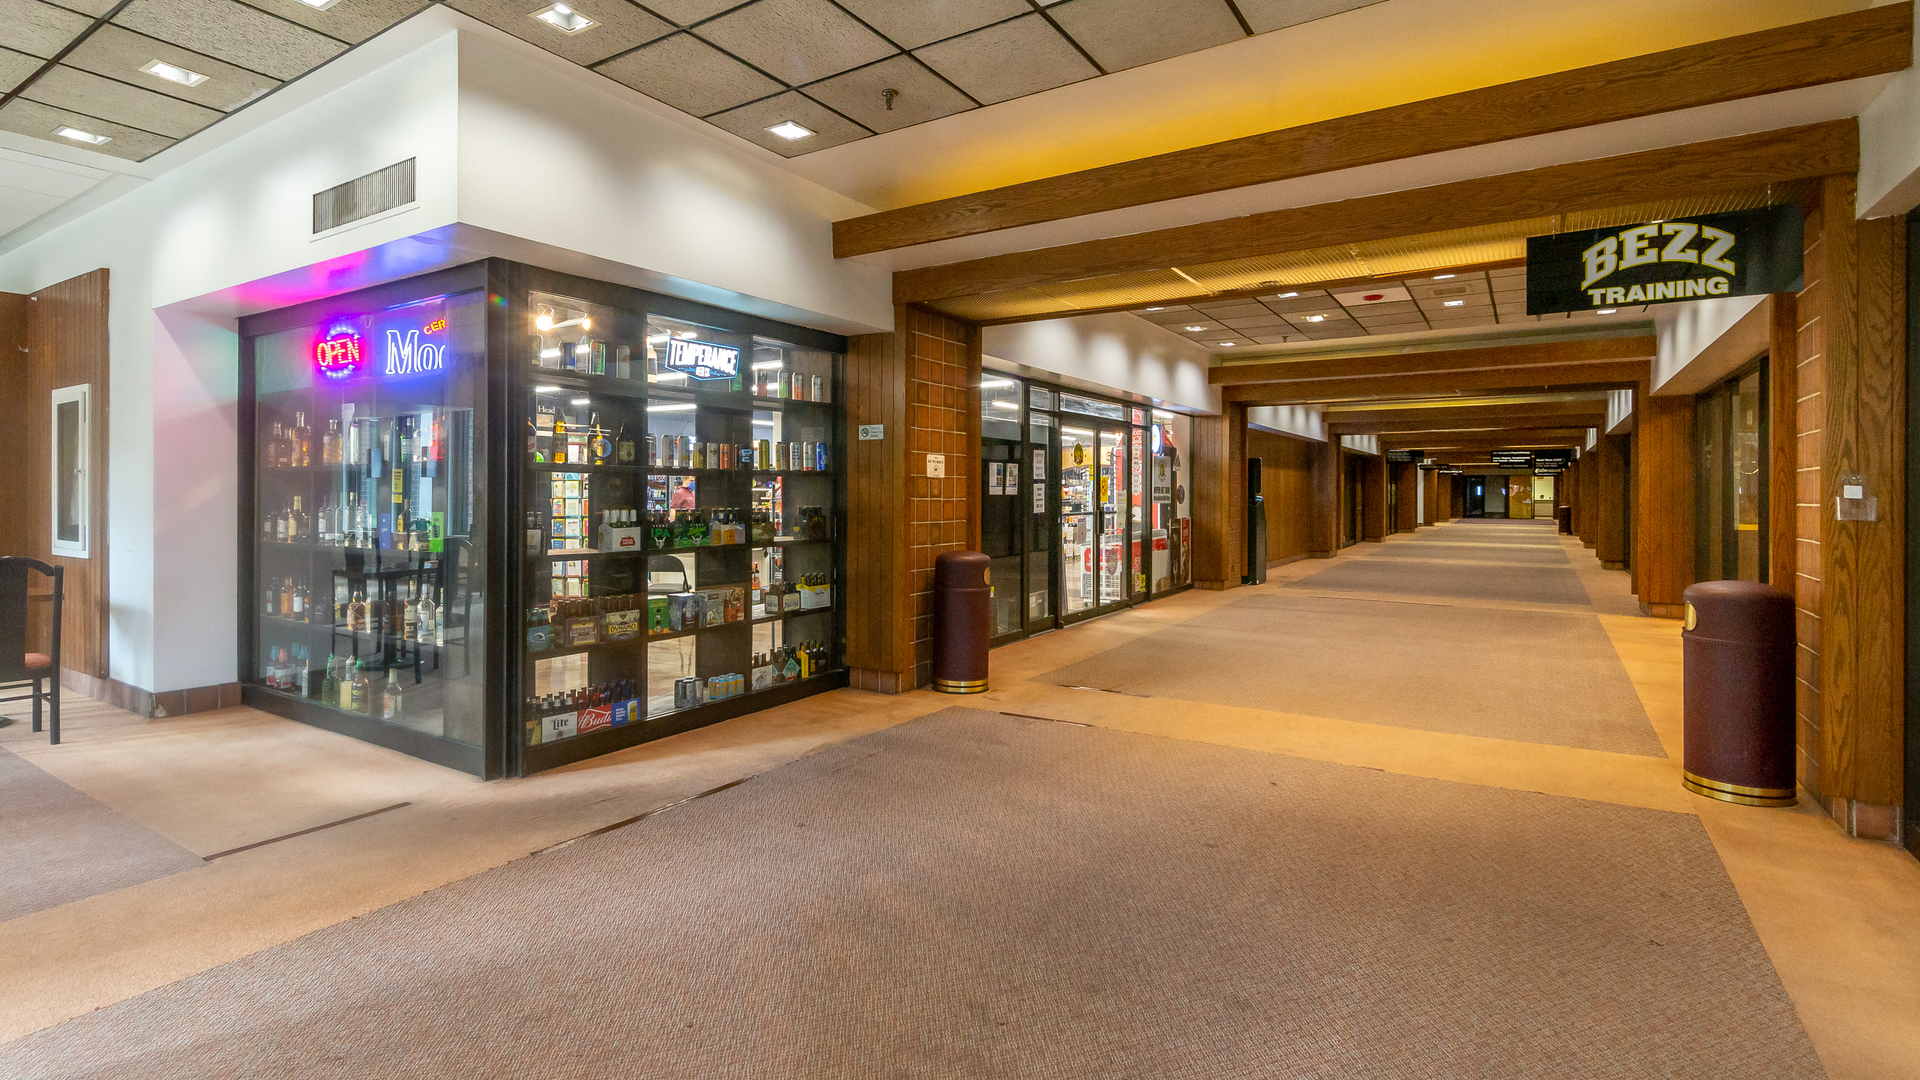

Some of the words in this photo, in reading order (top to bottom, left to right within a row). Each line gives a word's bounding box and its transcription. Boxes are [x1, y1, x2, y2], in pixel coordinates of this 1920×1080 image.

[1580, 222, 1736, 291] BEZZ
[1587, 276, 1729, 306] TRAINING
[317, 337, 360, 366] OPEN
[669, 339, 738, 376] TEMPERANCE
[538, 405, 556, 414] Head
[651, 528, 670, 538] IPA
[610, 623, 637, 633] DYNAMO
[553, 718, 569, 731] Lite
